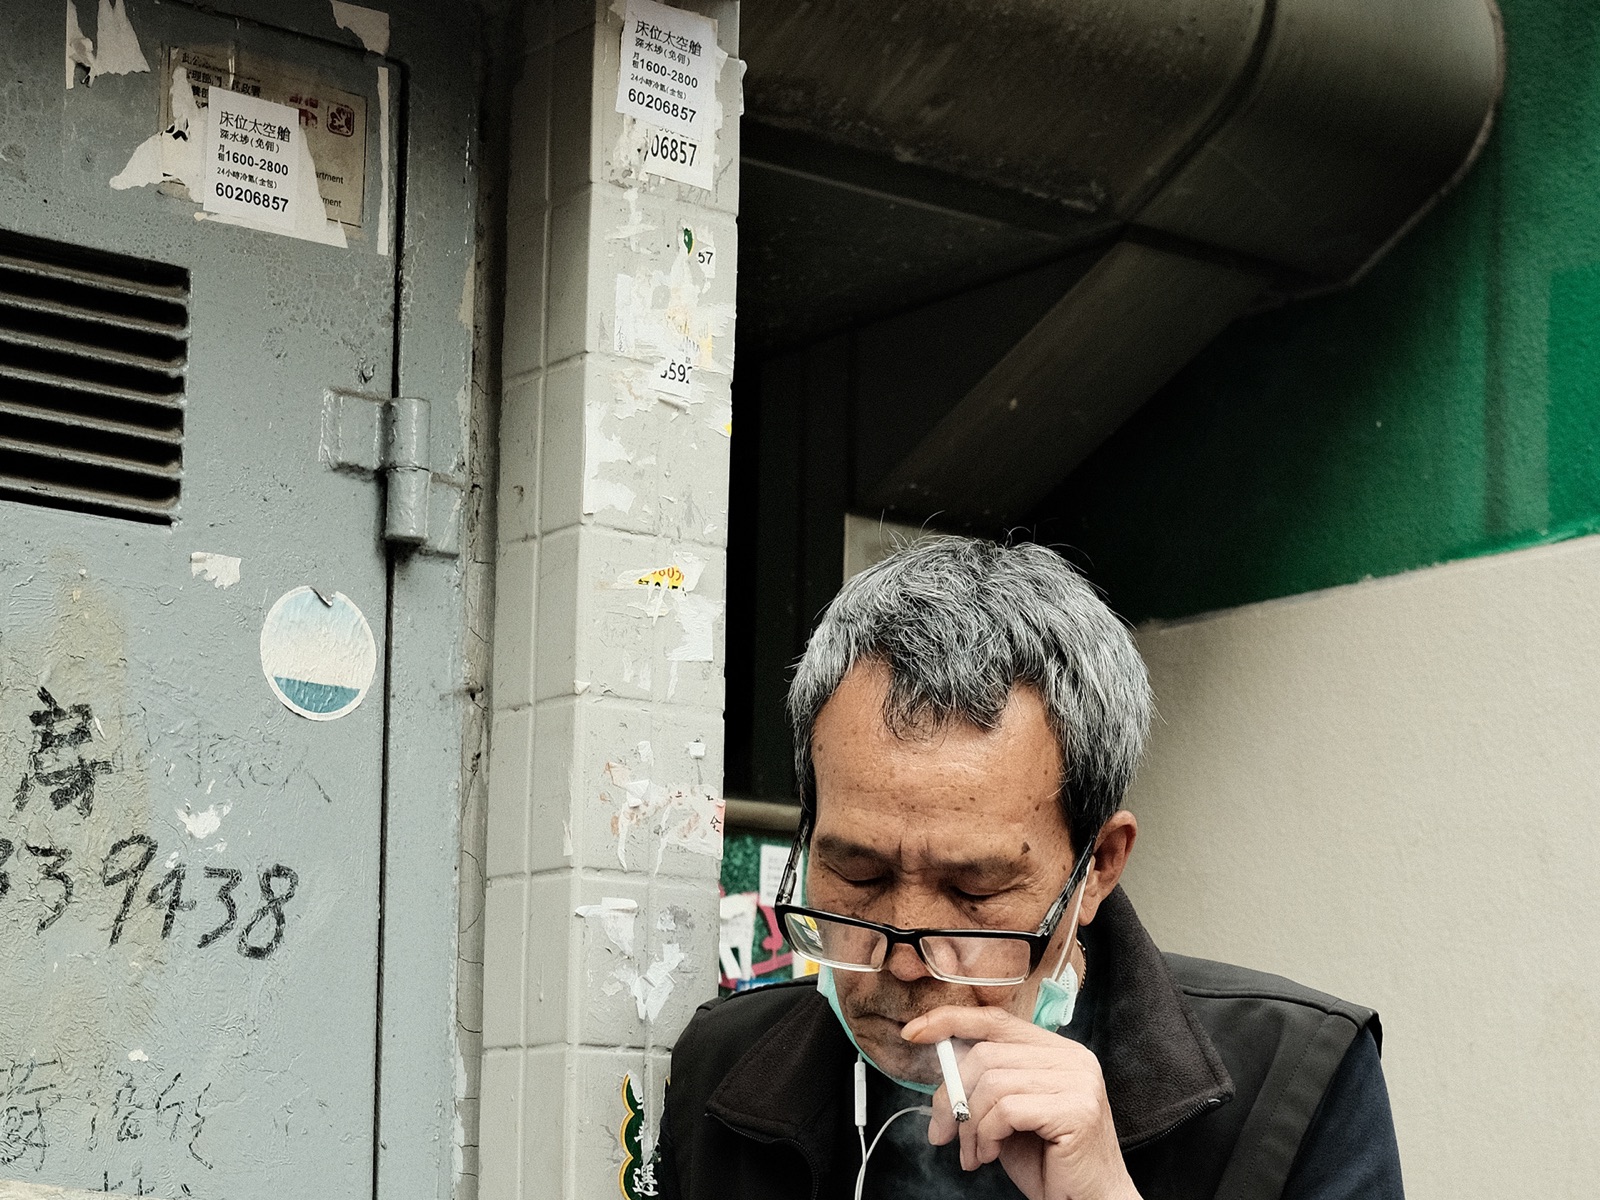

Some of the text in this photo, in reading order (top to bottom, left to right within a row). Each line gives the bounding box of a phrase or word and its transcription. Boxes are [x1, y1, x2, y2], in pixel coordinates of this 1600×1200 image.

[634, 20, 702, 58] 床位太空艙
[640, 58, 698, 89] 1600-2800
[628, 88, 697, 123] 60206857
[219, 110, 292, 143] 床位太空艙
[225, 150, 289, 176] 1600-2800
[215, 182, 289, 212] 60206857
[698, 251, 714, 265] 57
